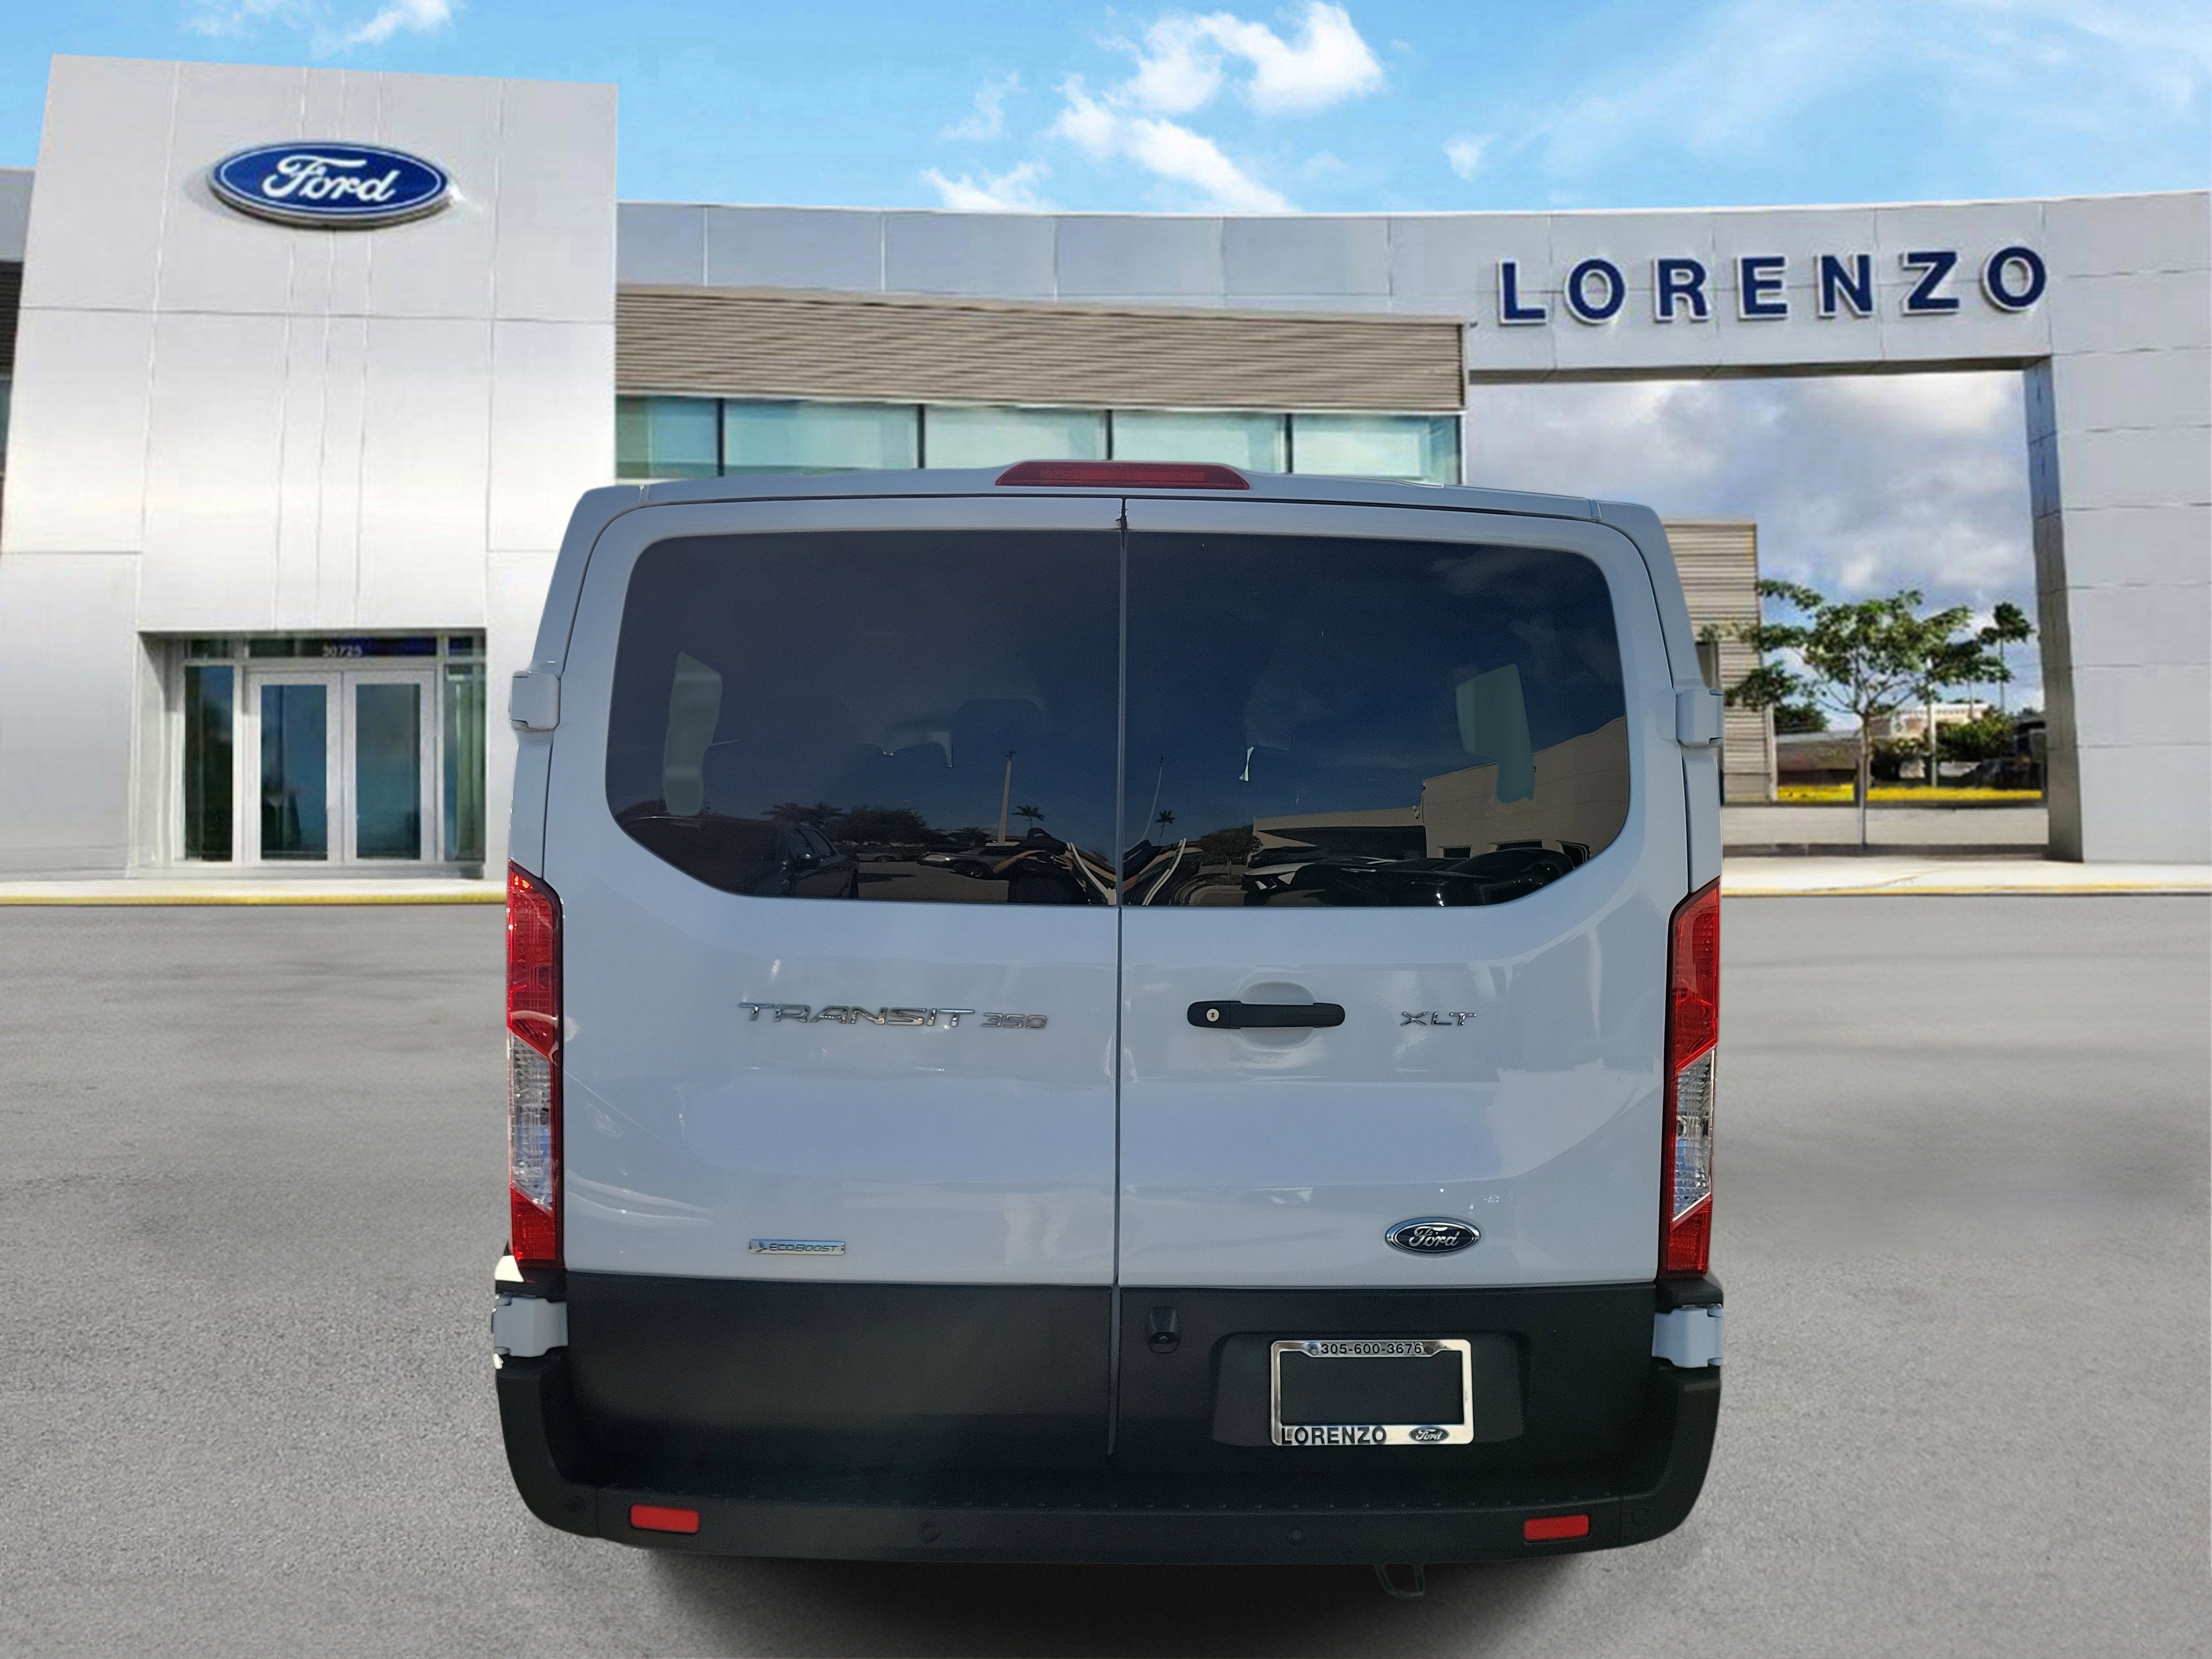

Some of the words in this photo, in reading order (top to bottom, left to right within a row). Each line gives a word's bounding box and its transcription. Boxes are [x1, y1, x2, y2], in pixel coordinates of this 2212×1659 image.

[262, 155, 401, 202] Ford
[1499, 246, 2047, 324] LORENZO
[738, 1002, 976, 1027] TRANSIT
[980, 1012, 1049, 1030] 350
[1400, 1011, 1477, 1027] XLT
[1408, 1226, 1460, 1247] Ford
[769, 1243, 839, 1252] ECOBOOST
[1321, 1343, 1424, 1354] 305-600-3676
[1282, 1426, 1387, 1446] LORENZO
[1415, 1429, 1443, 1441] Ford
